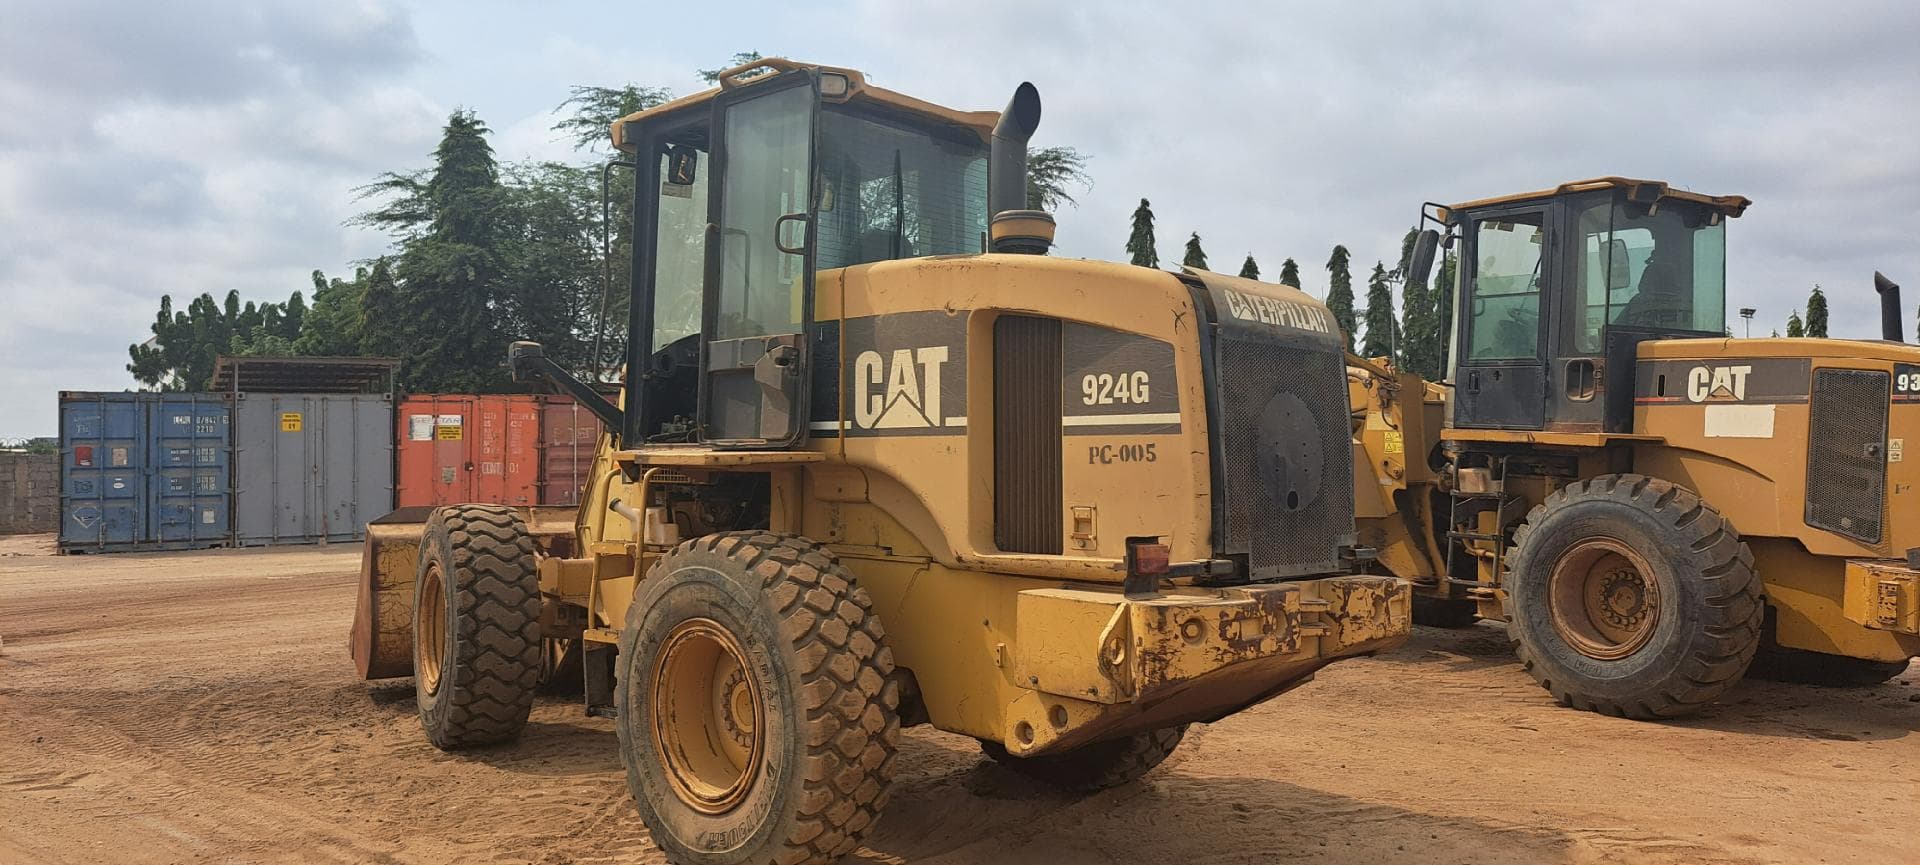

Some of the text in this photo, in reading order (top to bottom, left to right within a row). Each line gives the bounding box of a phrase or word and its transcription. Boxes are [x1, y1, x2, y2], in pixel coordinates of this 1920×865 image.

[1224, 288, 1329, 334] CATERPILLAR
[855, 346, 948, 429] CAT
[1082, 370, 1150, 406] 924G
[1687, 365, 1752, 403] CAT
[1088, 443, 1157, 465] PC-005
